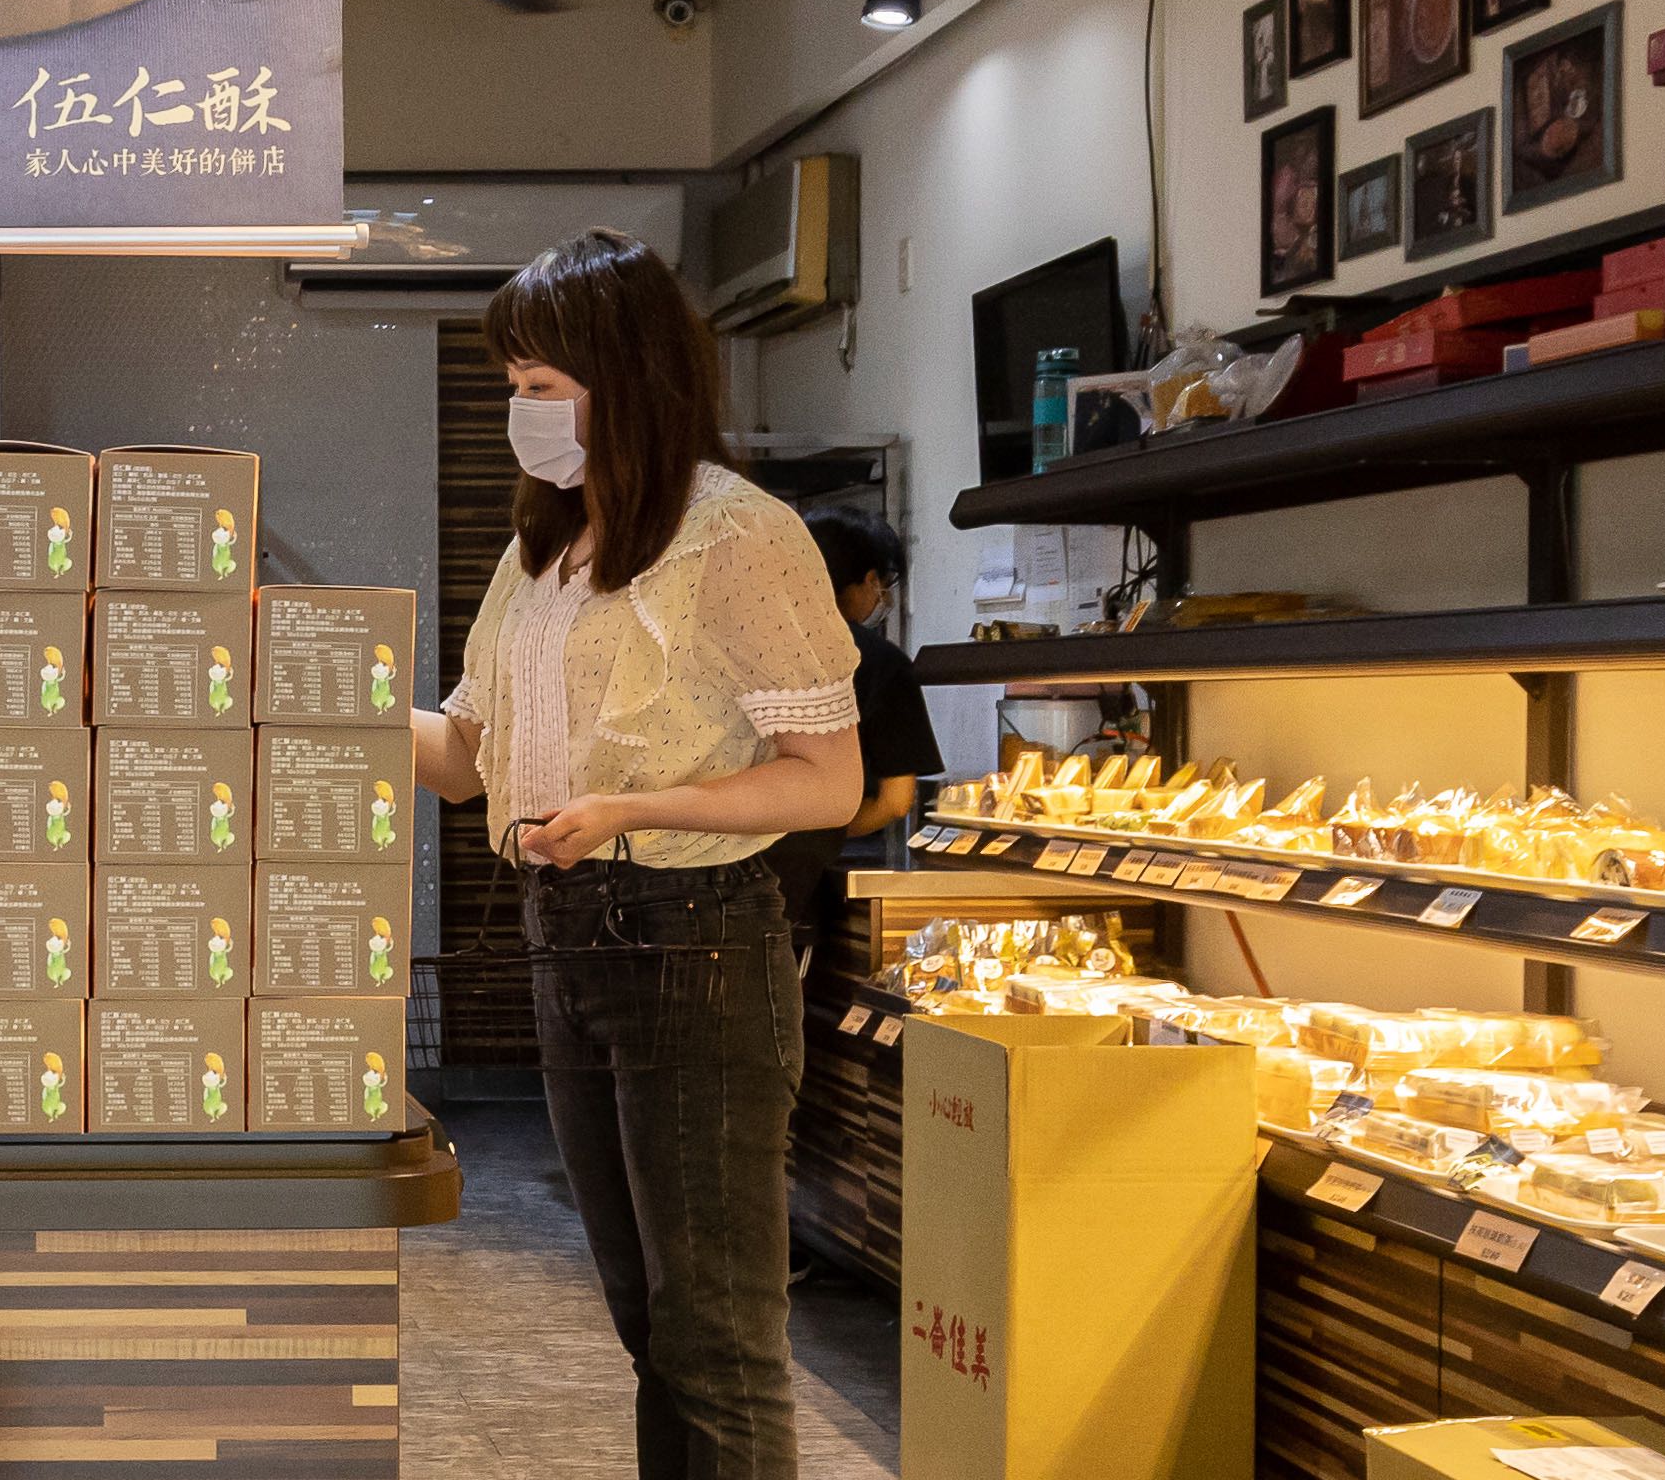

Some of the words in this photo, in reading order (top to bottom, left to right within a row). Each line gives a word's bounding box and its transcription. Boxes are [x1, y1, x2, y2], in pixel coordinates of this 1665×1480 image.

[11, 65, 292, 139] 伍仁酥
[25, 146, 286, 178] 家人心中美好的餅店
[912, 1300, 991, 1393] 二崙佳美
